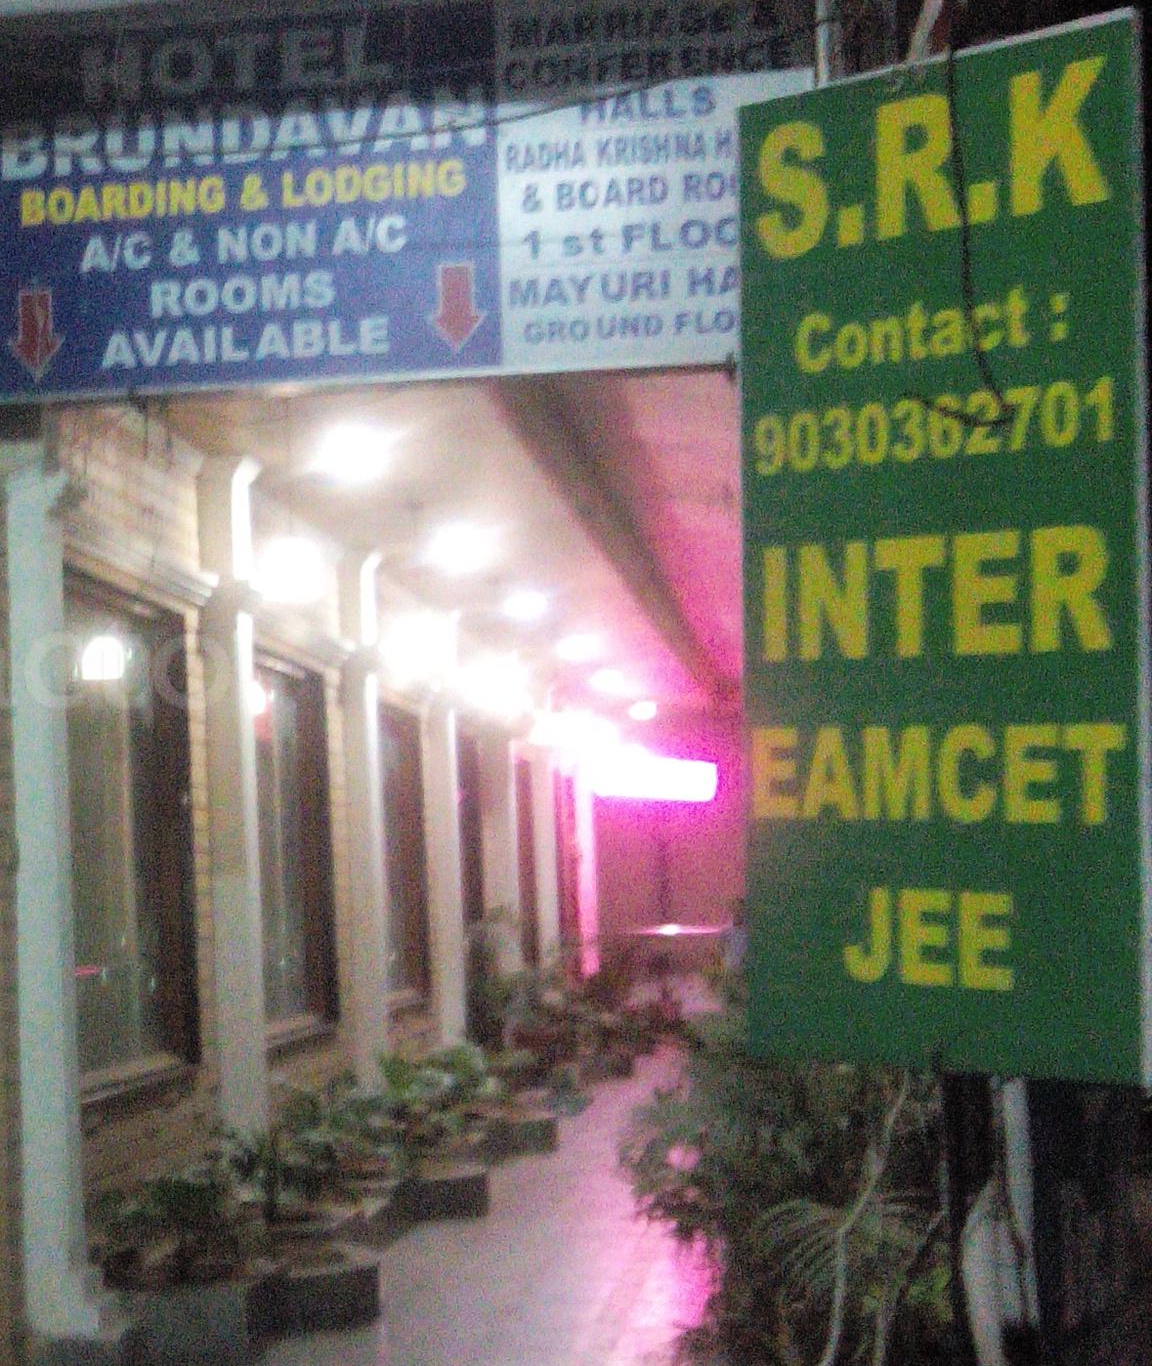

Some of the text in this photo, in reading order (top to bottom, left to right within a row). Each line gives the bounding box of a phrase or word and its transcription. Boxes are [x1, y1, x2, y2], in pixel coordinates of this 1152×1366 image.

[0, 88, 488, 181] BRUNDAVAN
[505, 140, 585, 173] RADHA
[599, 133, 706, 168] KRISHNA
[755, 55, 1112, 261] S.R.K
[21, 159, 468, 227] BOARDING & LODGING
[521, 184, 543, 213] &
[556, 176, 671, 212] BOARD
[80, 214, 408, 274] A/C & NON A/C
[525, 229, 540, 260] 1
[150, 270, 336, 319] ROOMS
[101, 317, 391, 371] AVAILABLE
[524, 316, 663, 343] GROUND
[795, 287, 1032, 375] Contact
[761, 523, 1112, 662] INTER
[750, 722, 1127, 825] EAMCET
[845, 887, 1015, 991] JEE
